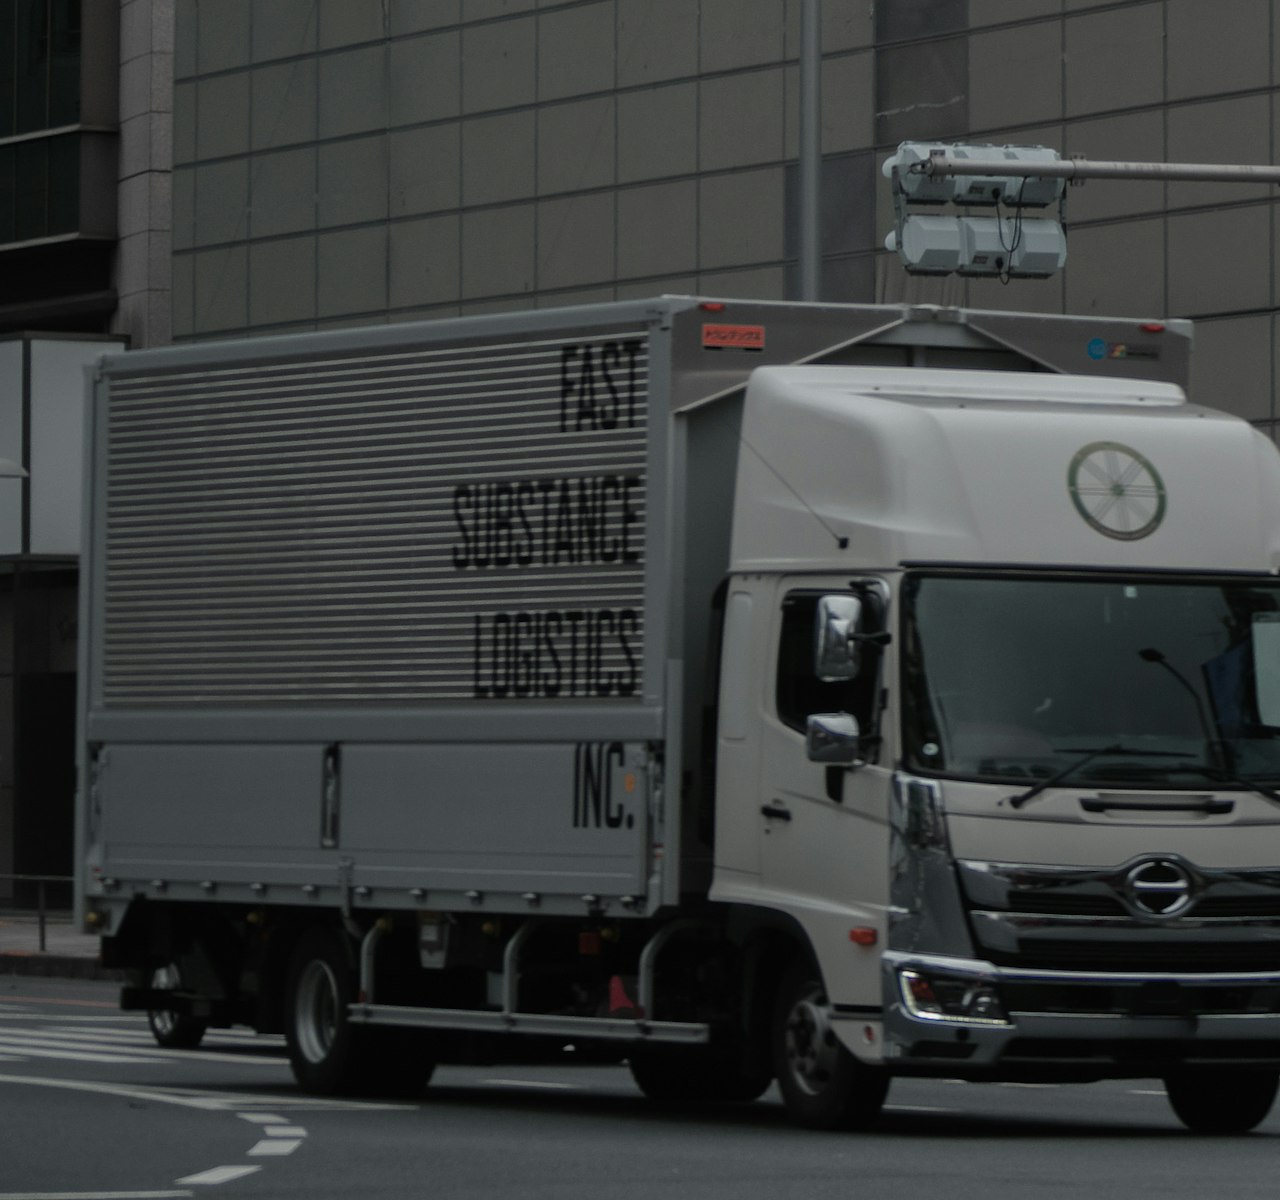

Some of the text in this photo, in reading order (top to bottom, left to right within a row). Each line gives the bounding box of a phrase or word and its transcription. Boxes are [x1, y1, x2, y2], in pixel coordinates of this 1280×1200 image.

[559, 340, 643, 433] FAST
[452, 476, 641, 569] SUBSTANCE
[474, 609, 641, 699] LOGISTICS
[573, 741, 635, 829] INC.
